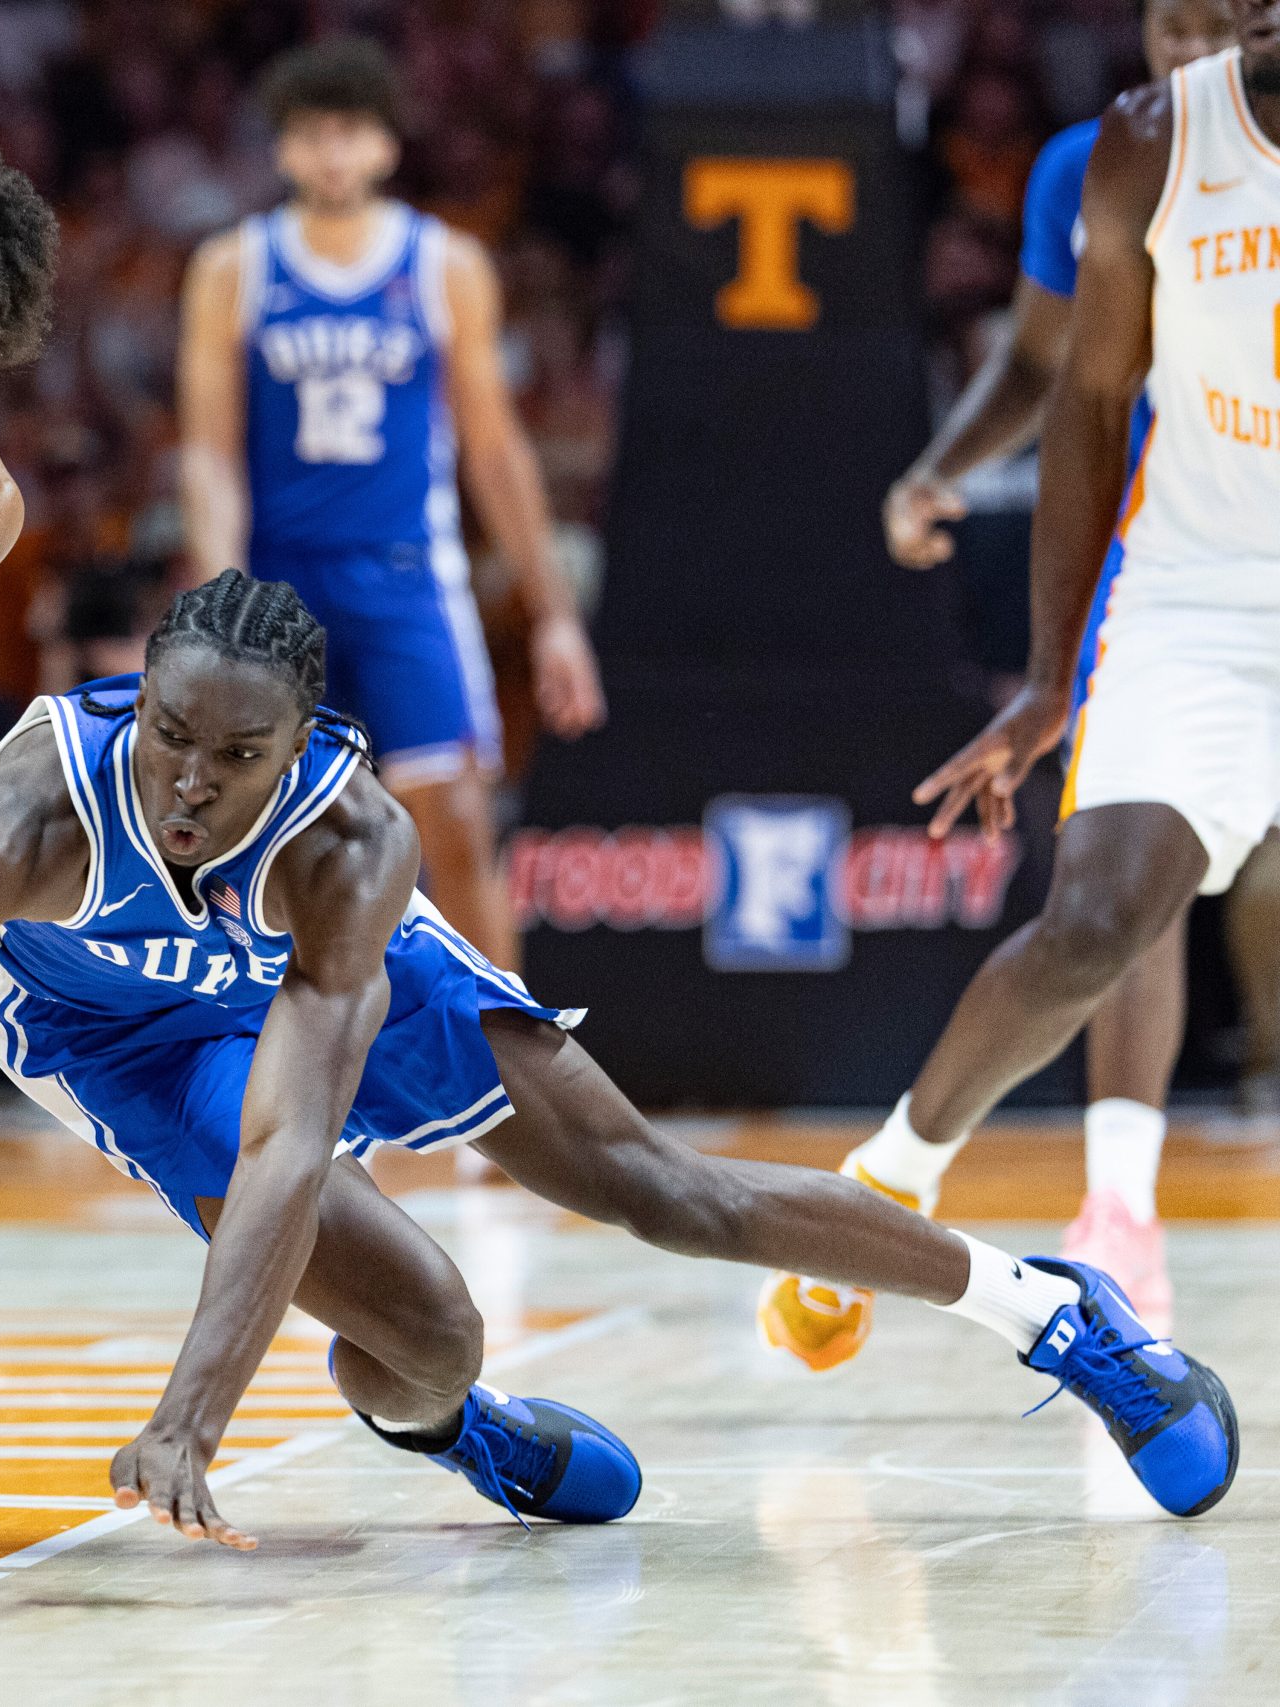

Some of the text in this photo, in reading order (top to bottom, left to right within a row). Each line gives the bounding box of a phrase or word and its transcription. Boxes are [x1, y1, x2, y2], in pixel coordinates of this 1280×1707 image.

[683, 156, 855, 333] T
[294, 371, 386, 465] 12
[1200, 374, 1280, 450] OLU
[509, 806, 1016, 950] FOOD F CITY
[83, 937, 288, 995] DUKE
